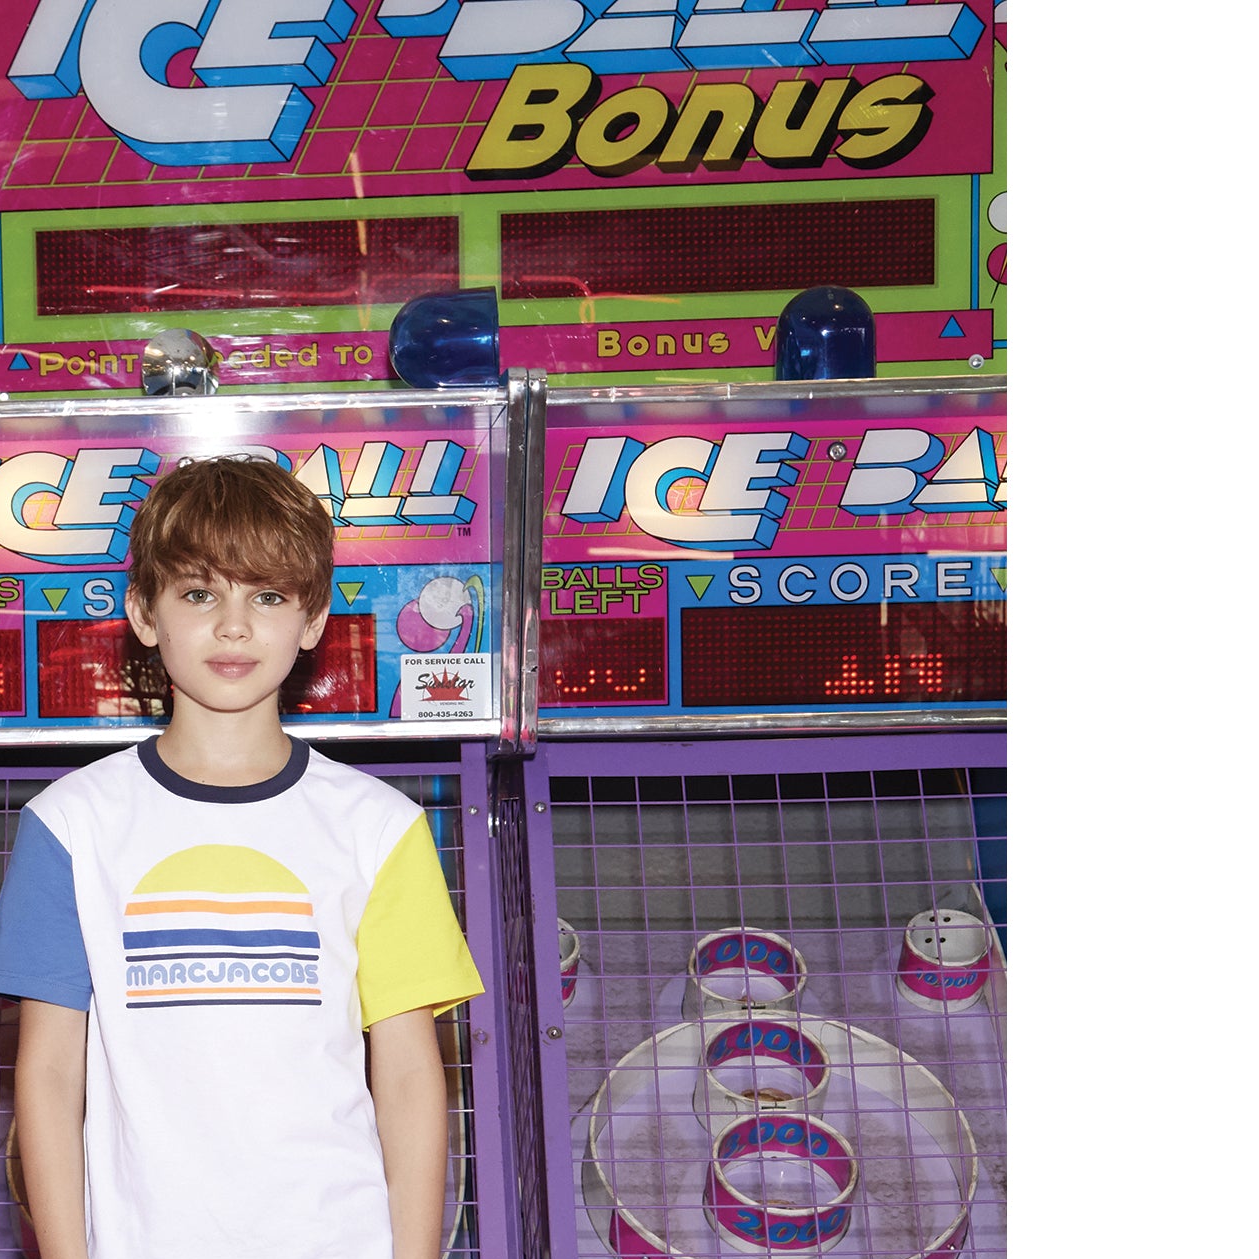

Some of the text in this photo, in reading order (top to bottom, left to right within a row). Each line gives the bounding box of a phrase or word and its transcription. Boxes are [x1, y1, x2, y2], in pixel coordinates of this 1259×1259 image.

[464, 62, 935, 181] Bonus
[597, 329, 729, 357] Bonus
[179, 440, 477, 527] ALL
[561, 426, 1007, 551] ICE BA
[541, 564, 663, 590] BALLS
[728, 561, 973, 604] SCORE
[549, 589, 650, 615] LEFT
[404, 658, 423, 666] FOR
[464, 657, 486, 665] CALL
[418, 710, 474, 718] 800-435-4263
